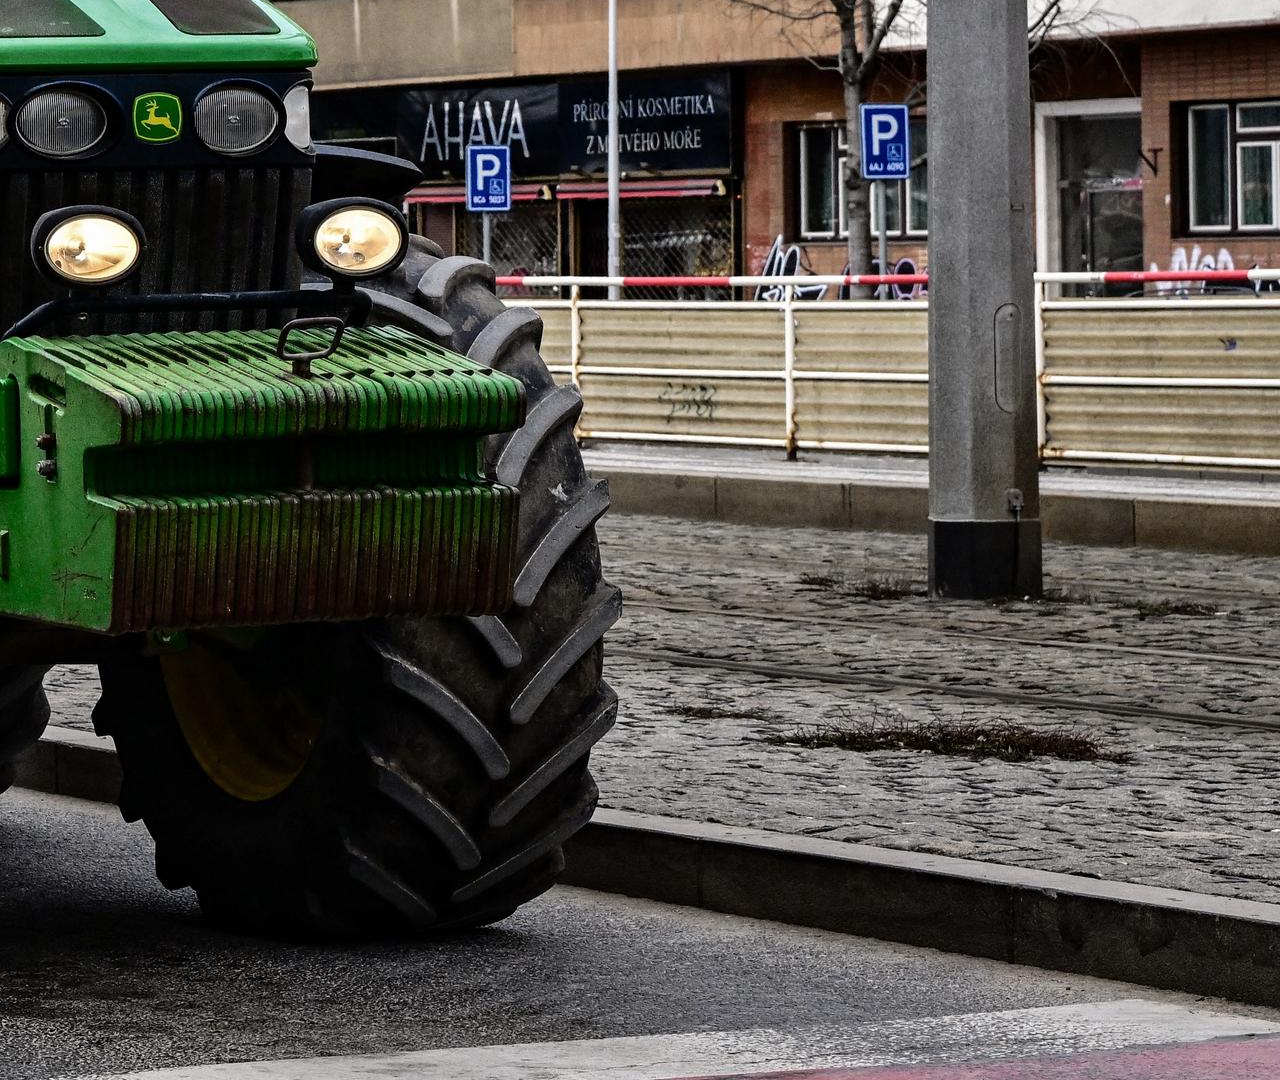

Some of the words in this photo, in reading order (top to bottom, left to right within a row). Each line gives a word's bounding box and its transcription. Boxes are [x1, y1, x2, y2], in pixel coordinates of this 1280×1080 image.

[573, 94, 634, 122] PŘÍRONÍ
[637, 94, 715, 118] KOSMETIKA
[420, 99, 530, 162] AHAVA
[586, 135, 595, 155] Z
[597, 127, 660, 154] MTVÉHO
[663, 125, 702, 150] MOŘE
[871, 113, 899, 156] P
[476, 153, 501, 191] P
